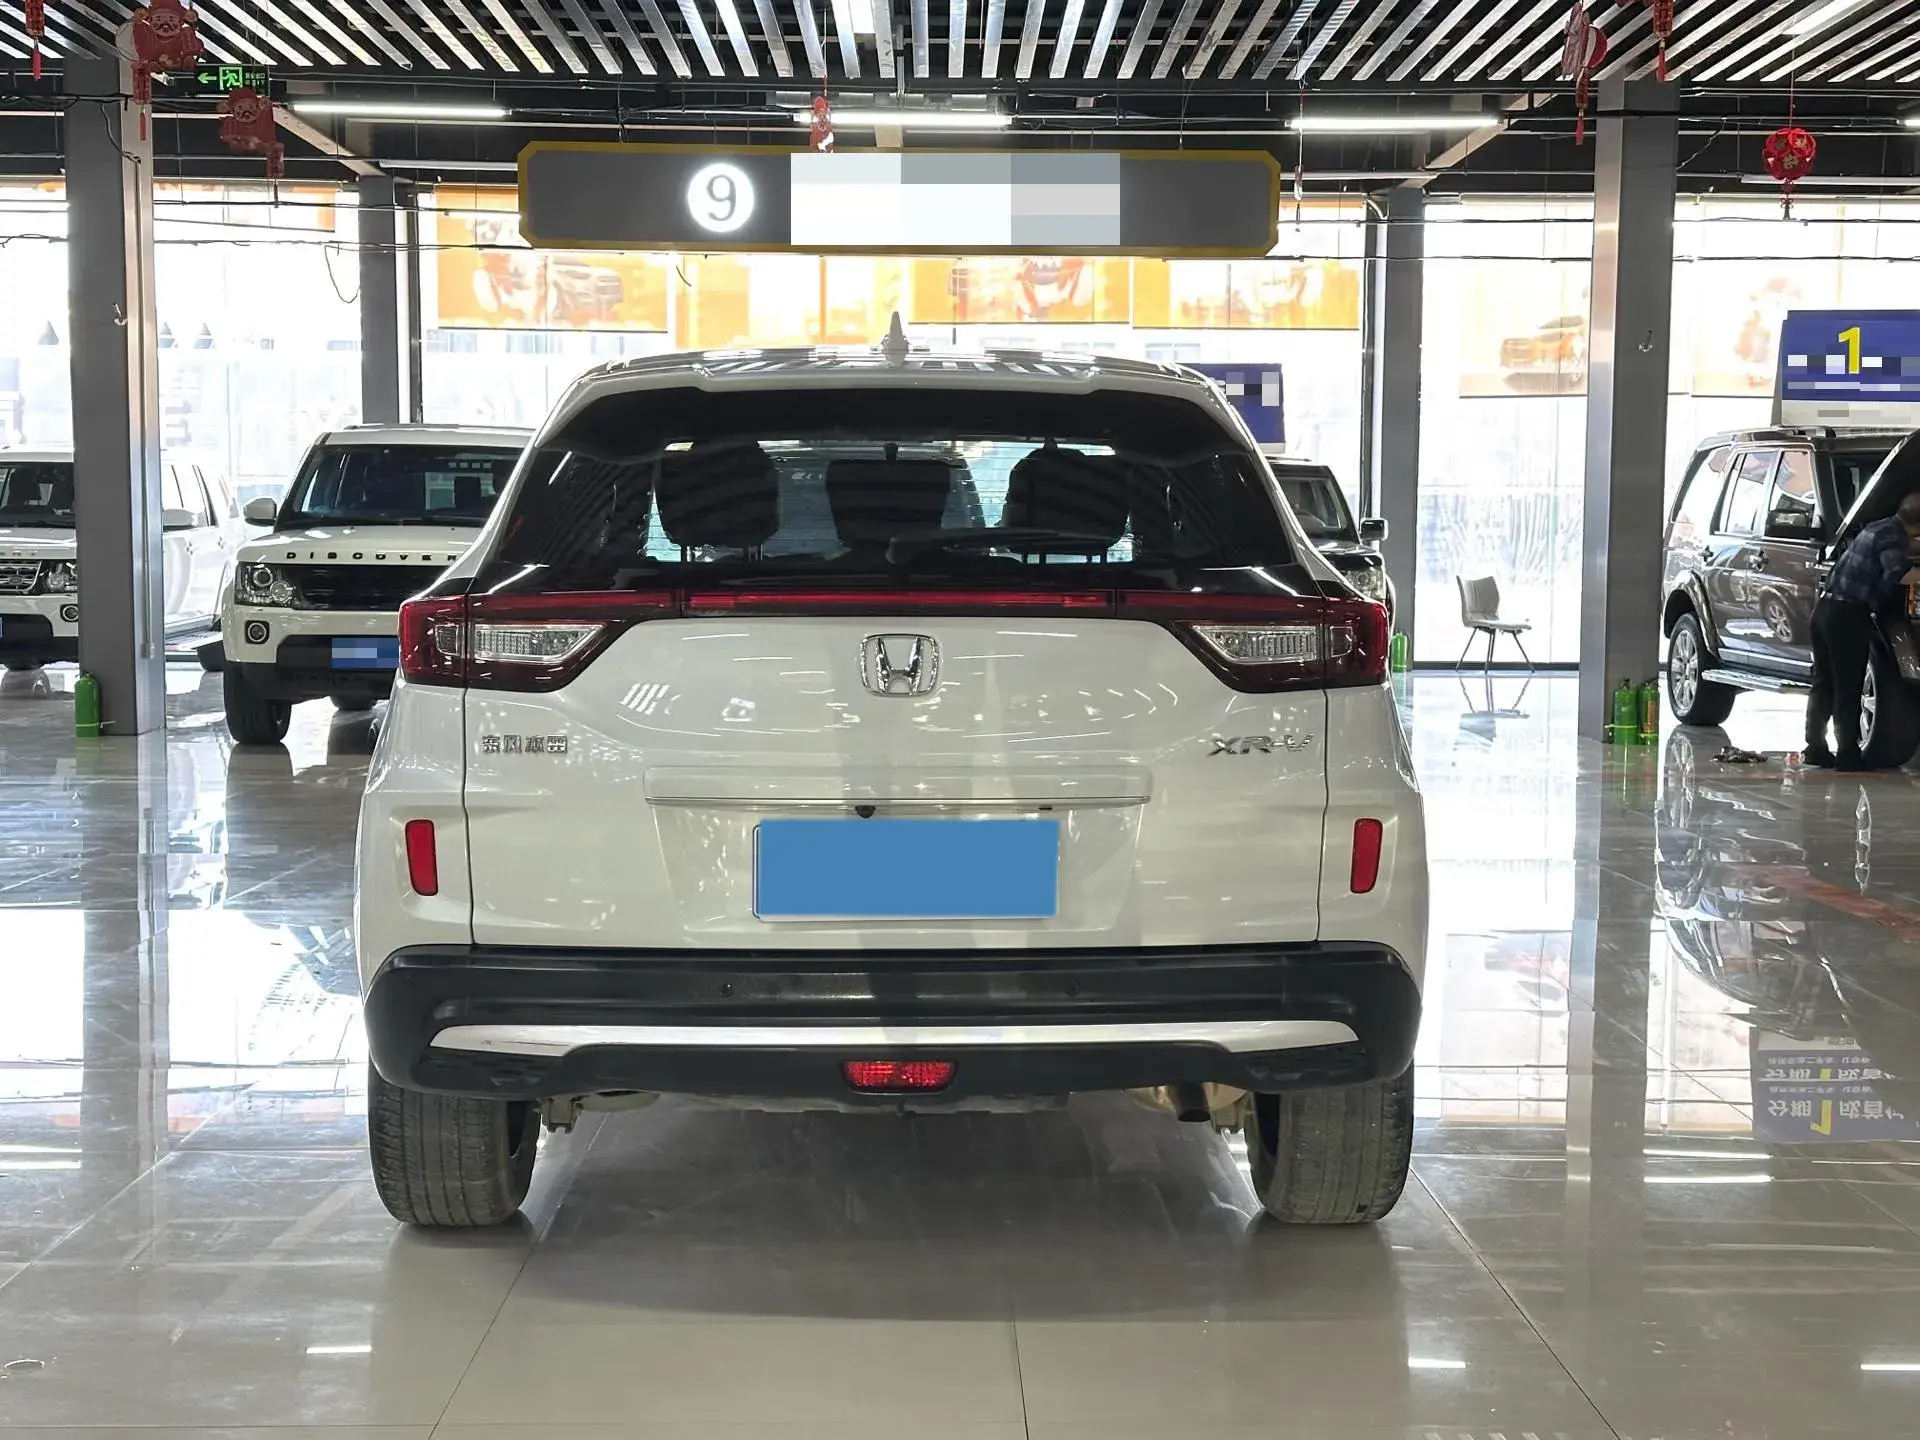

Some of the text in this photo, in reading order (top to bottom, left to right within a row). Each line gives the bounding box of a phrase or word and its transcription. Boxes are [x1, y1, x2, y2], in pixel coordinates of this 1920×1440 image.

[706, 174, 737, 222] 9
[1838, 326, 1861, 375] 1
[1208, 733, 1316, 757] XR-V
